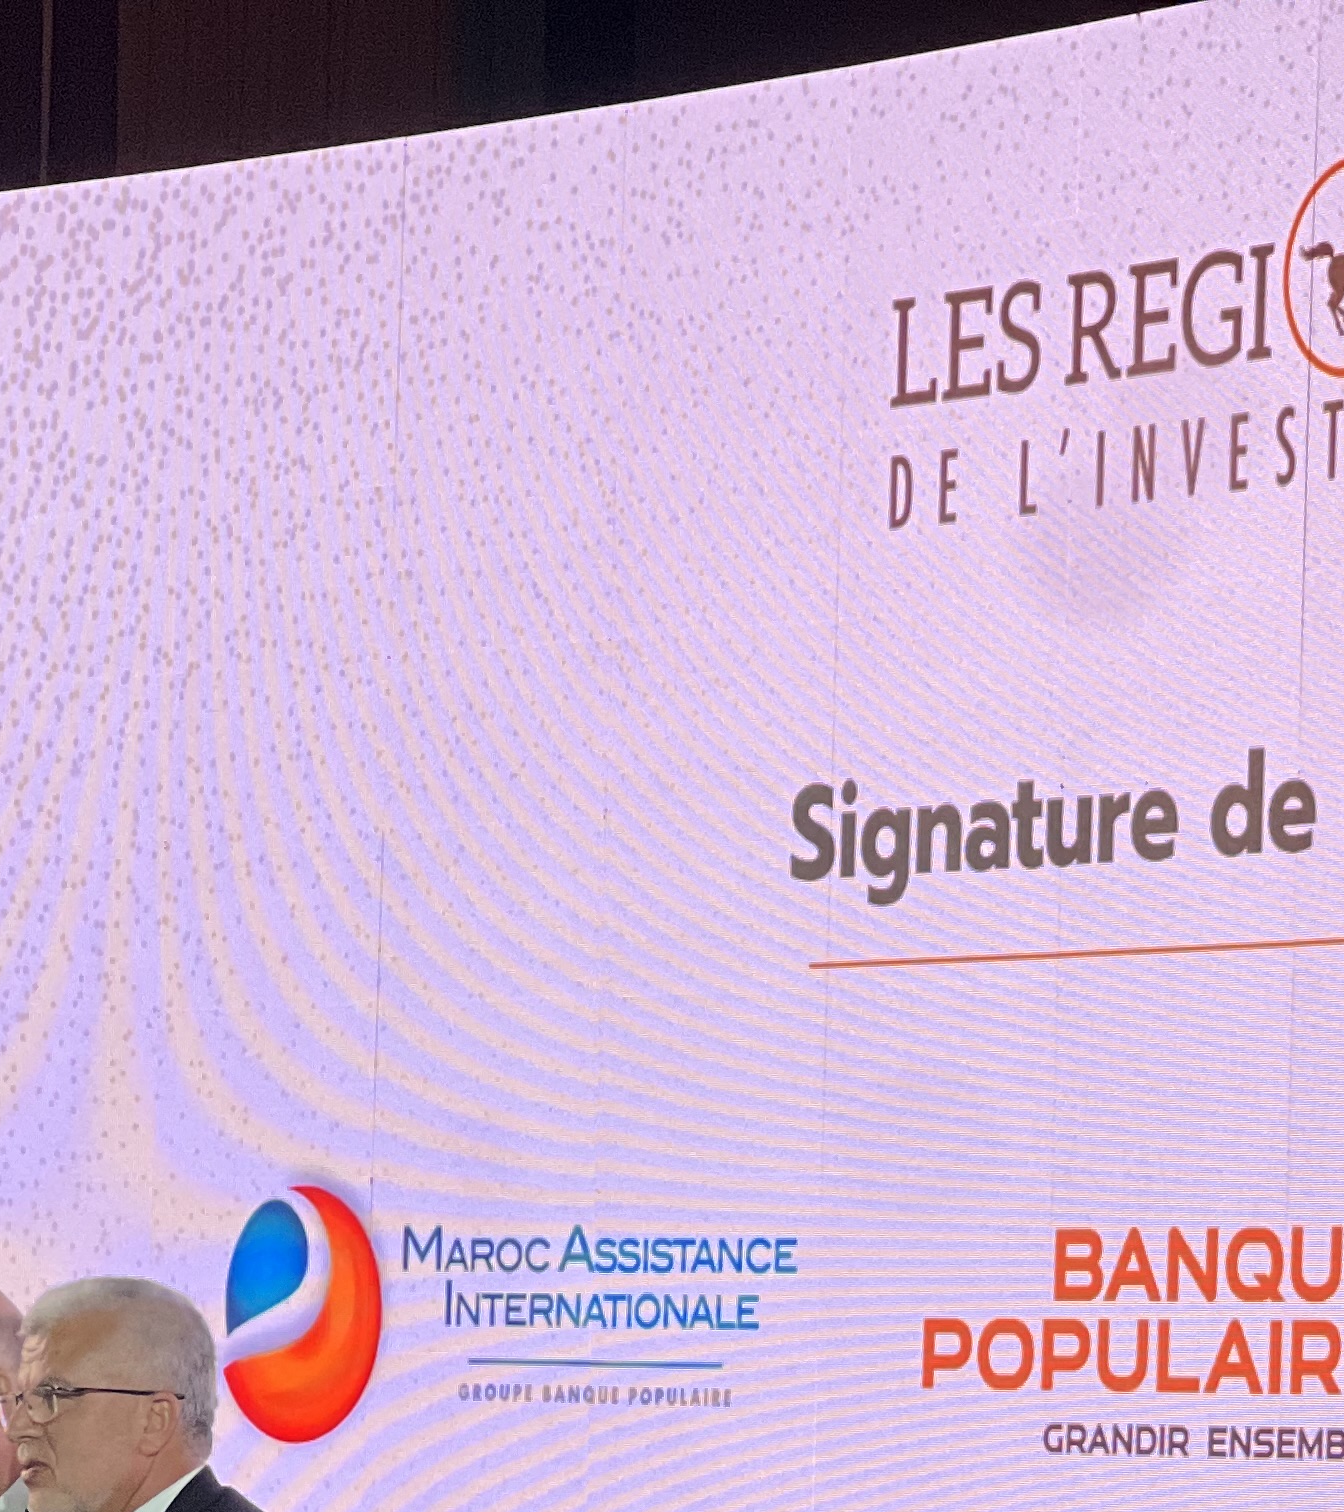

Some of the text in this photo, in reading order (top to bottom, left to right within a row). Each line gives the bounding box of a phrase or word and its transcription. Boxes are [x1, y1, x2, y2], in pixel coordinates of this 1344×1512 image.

[890, 281, 1042, 409] LES
[888, 447, 958, 530] DE
[789, 775, 1180, 906] Signature
[1209, 745, 1317, 858] de
[457, 1382, 733, 1408] GROUPE BANQUE POPULAIRE
[1042, 1423, 1189, 1458] GRANDIR
